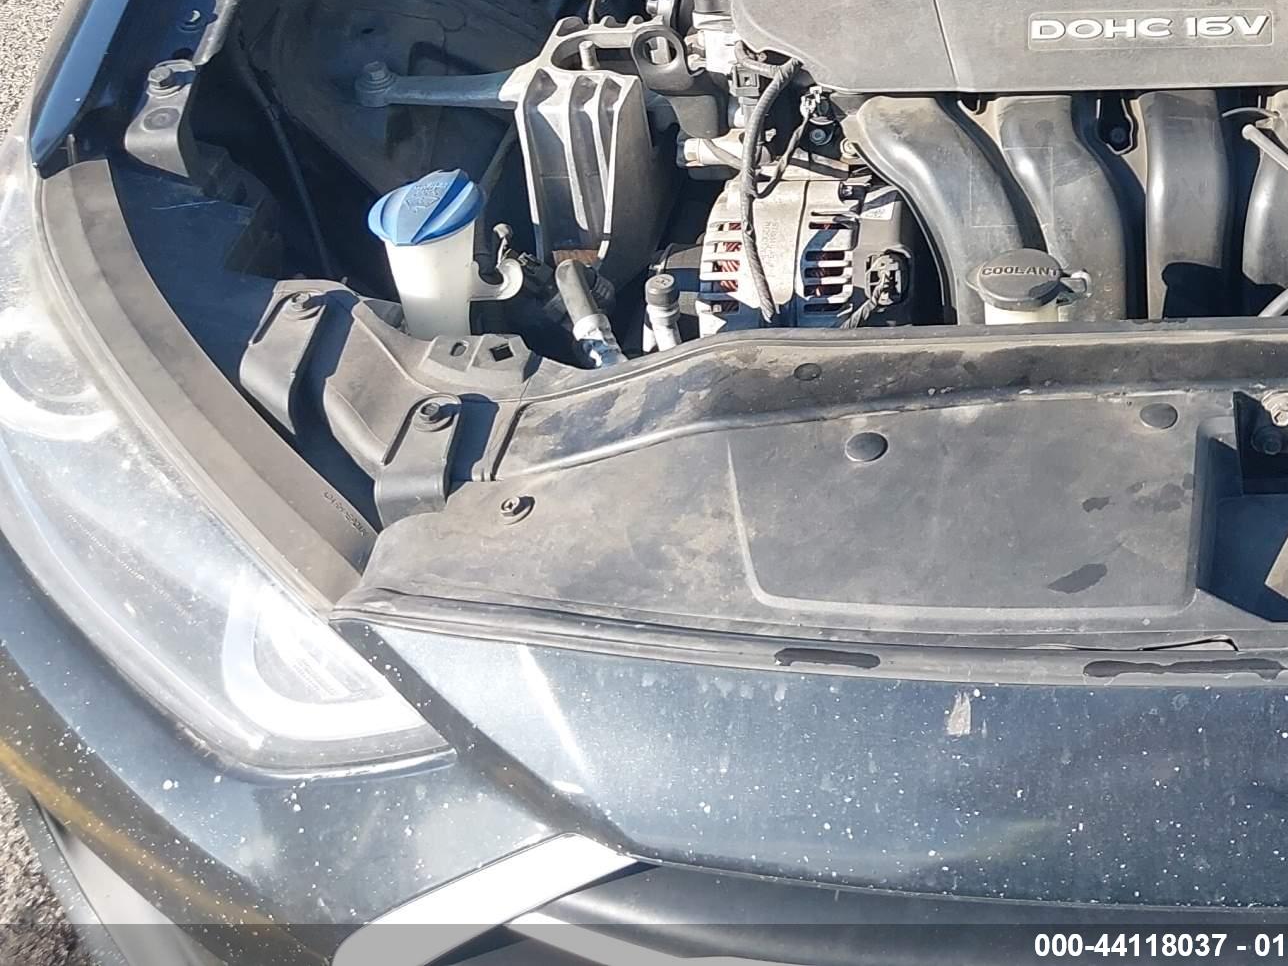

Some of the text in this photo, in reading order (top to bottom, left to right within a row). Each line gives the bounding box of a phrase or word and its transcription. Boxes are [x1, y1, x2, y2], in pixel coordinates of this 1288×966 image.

[1031, 15, 1270, 41] DOHC 16V
[981, 265, 1058, 276] COOLANT
